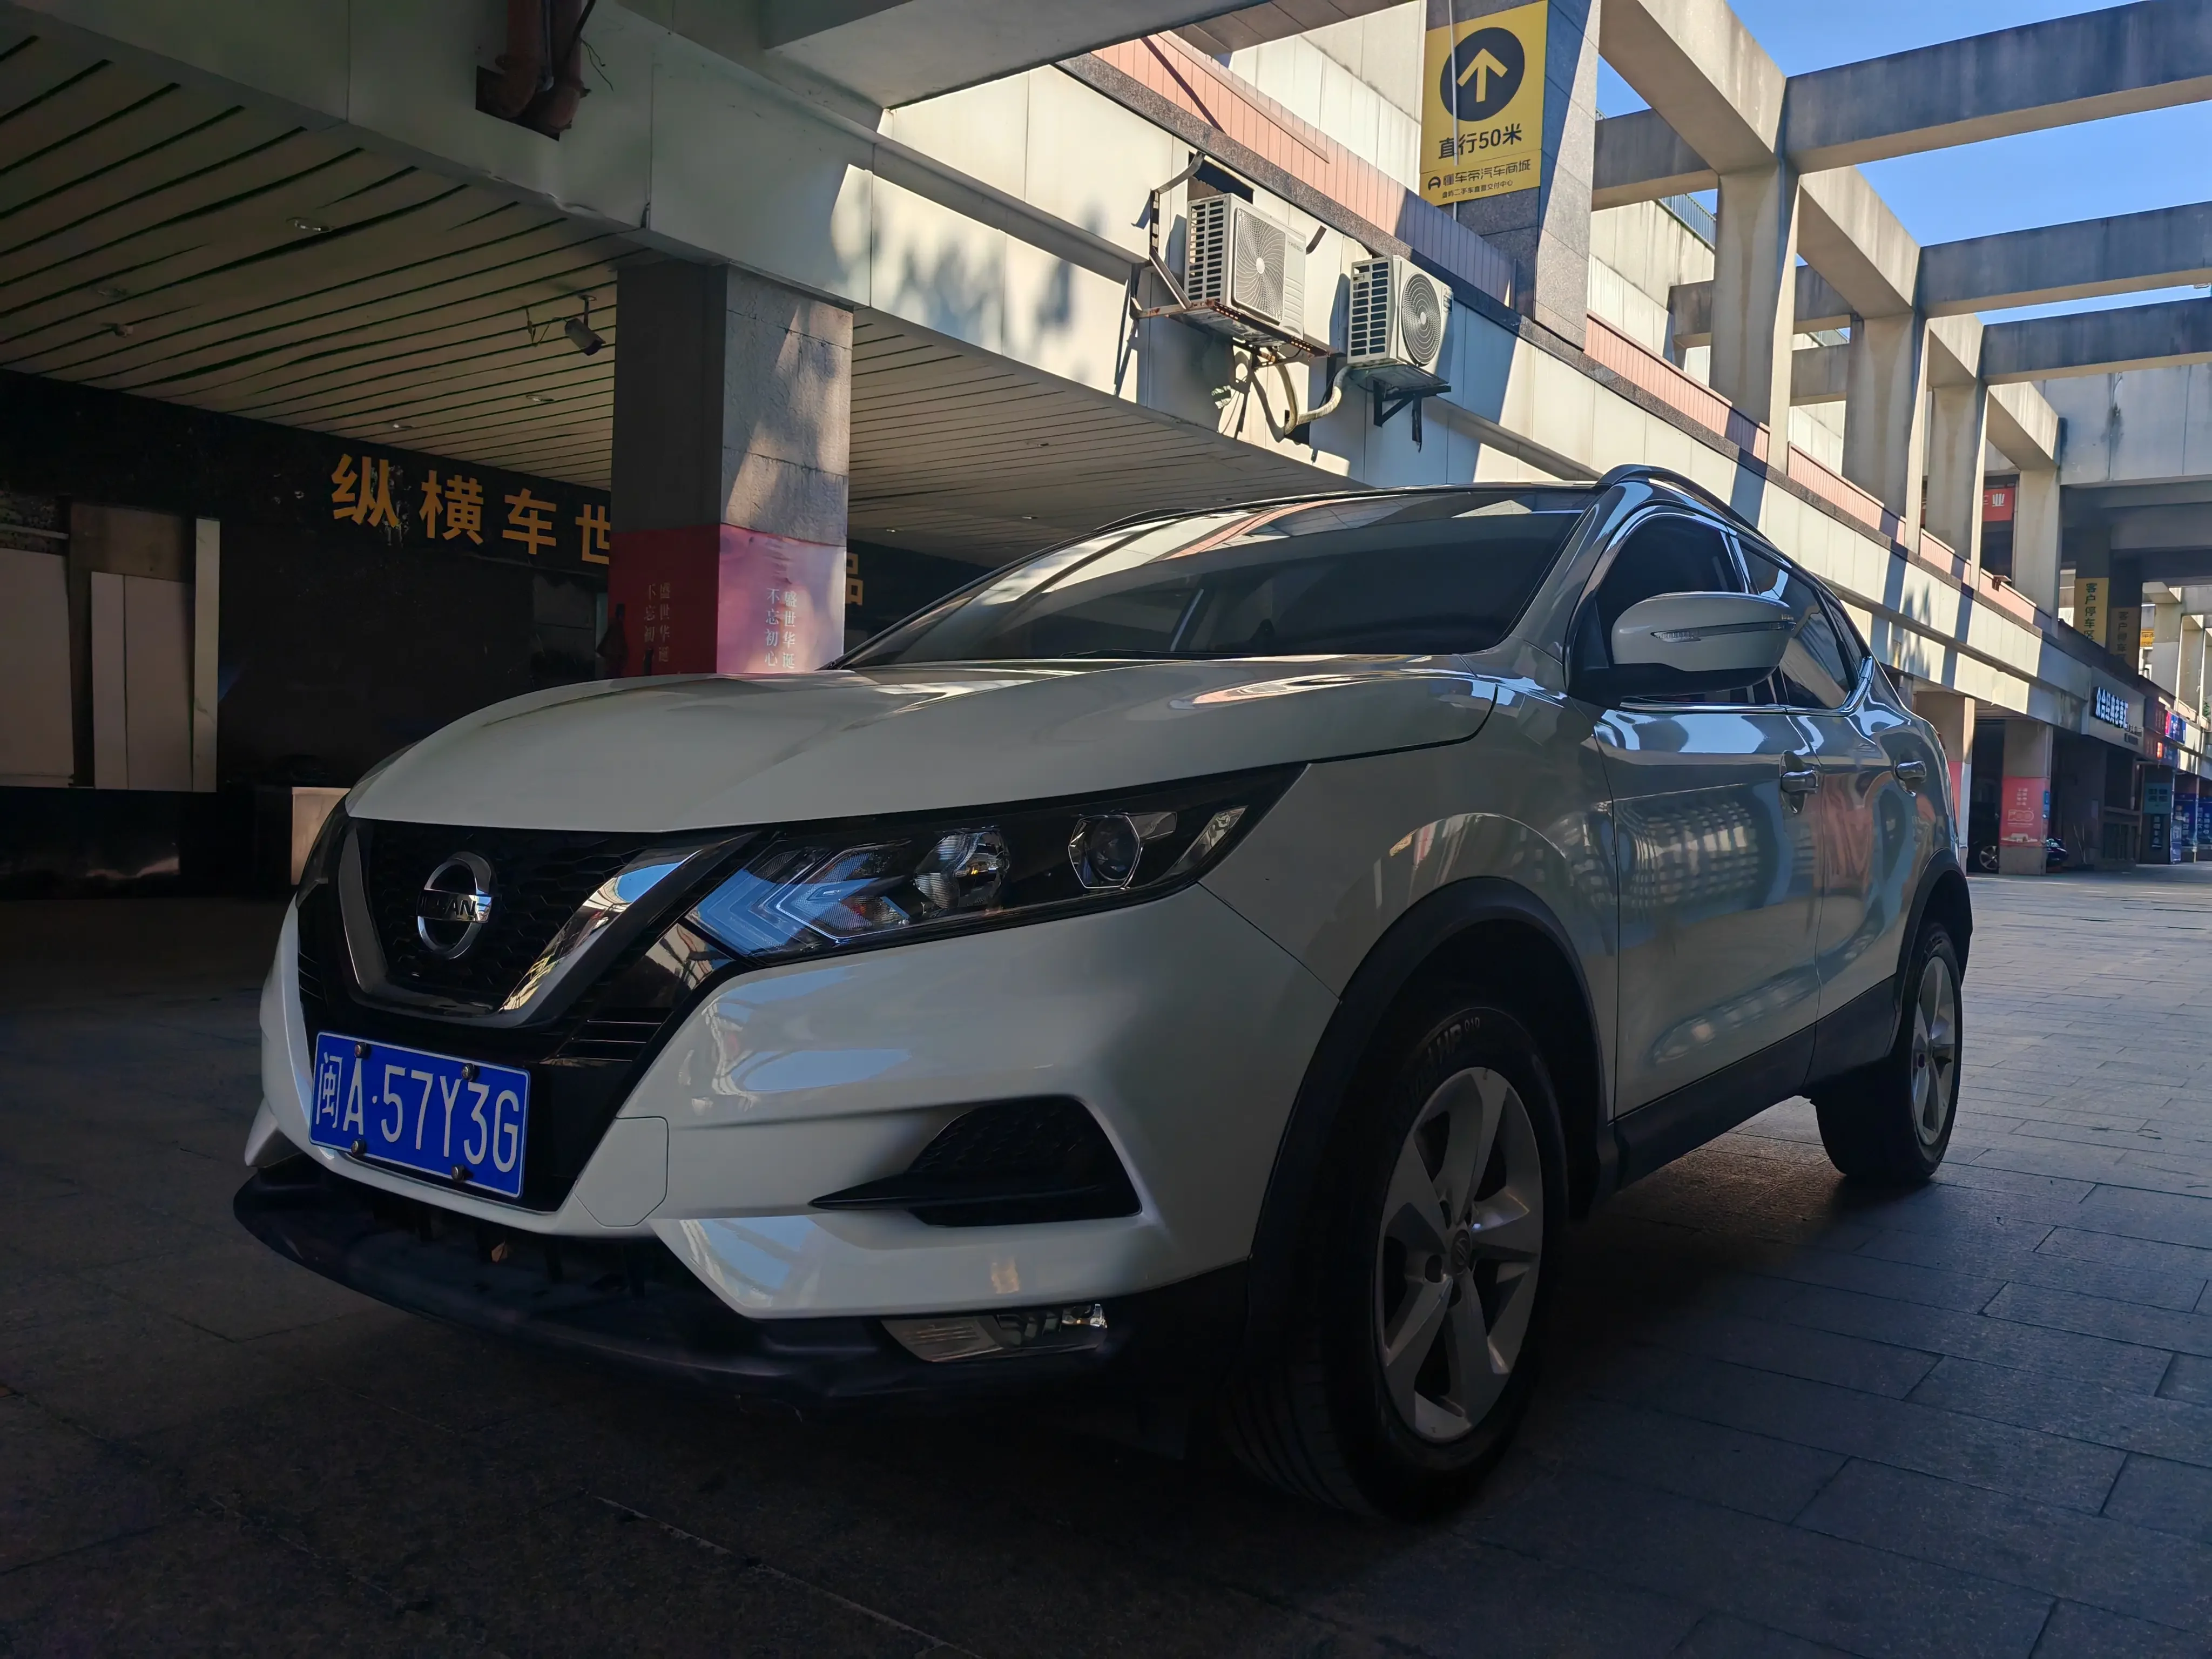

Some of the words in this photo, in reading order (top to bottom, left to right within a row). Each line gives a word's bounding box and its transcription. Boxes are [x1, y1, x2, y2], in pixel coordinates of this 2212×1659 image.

[1438, 123, 1522, 159] 直行50米
[331, 453, 611, 566] 纵横车世
[765, 588, 780, 667] 不忘初心
[783, 591, 797, 669] 盛世华诞
